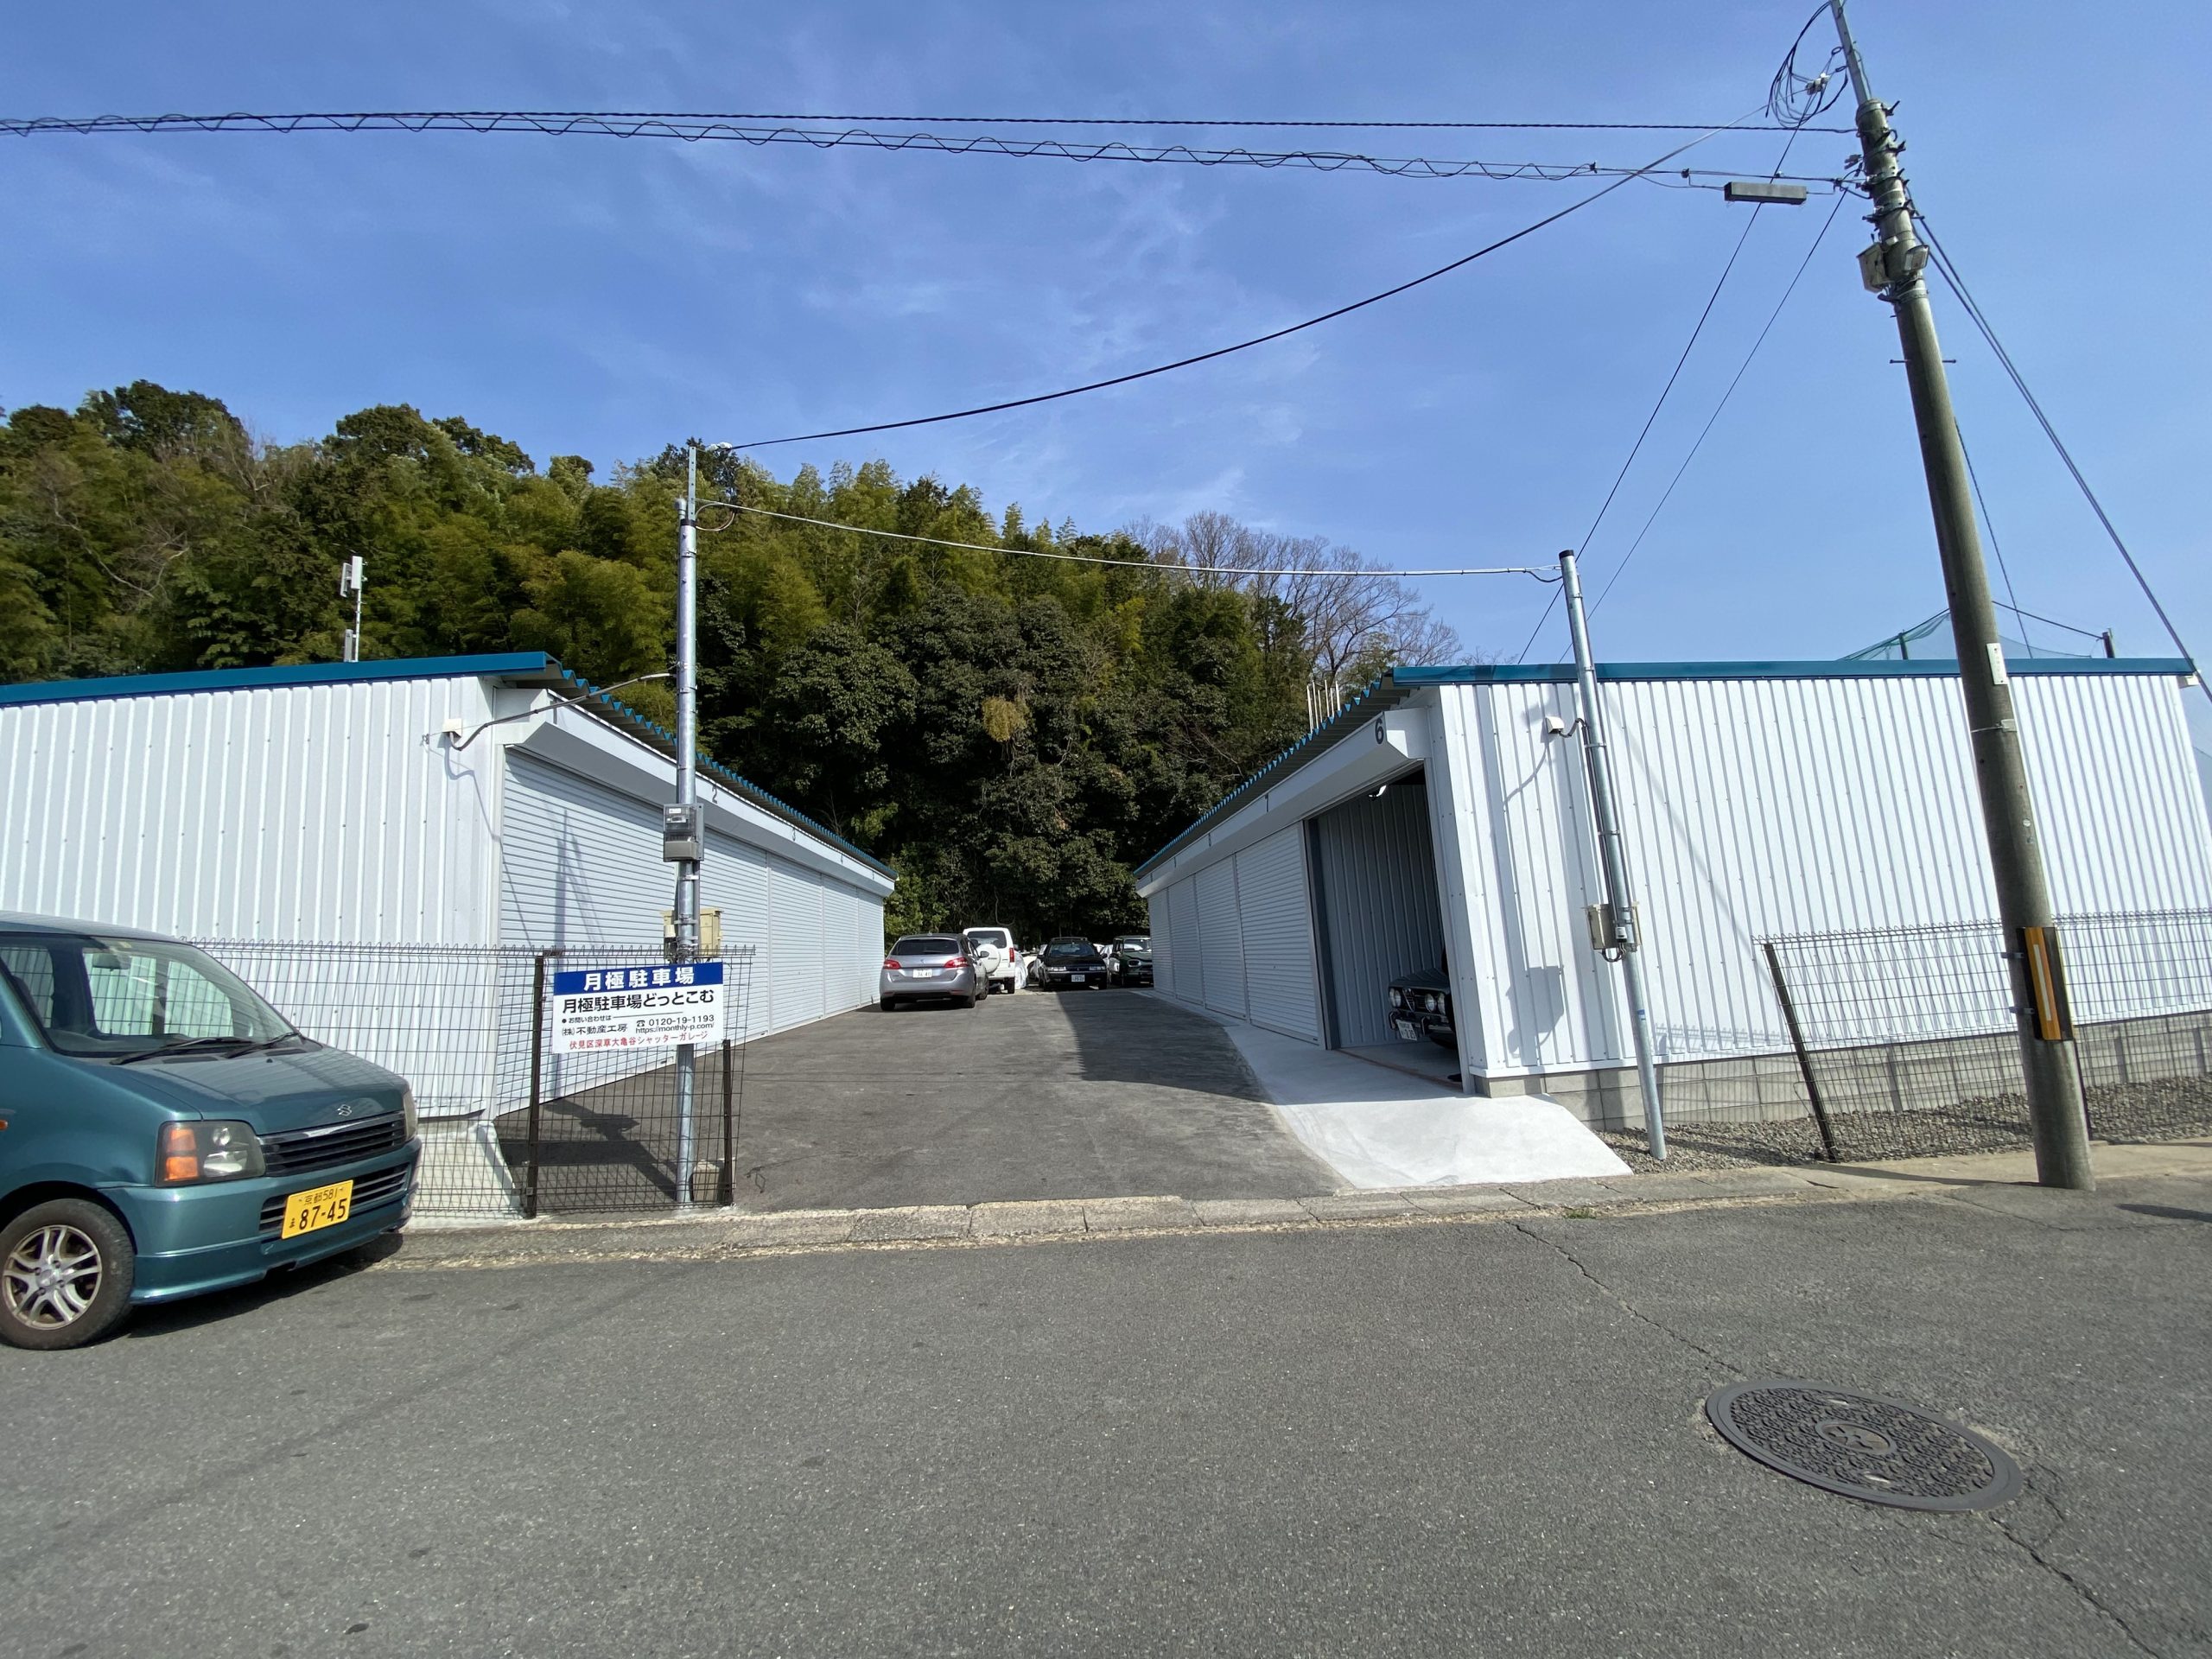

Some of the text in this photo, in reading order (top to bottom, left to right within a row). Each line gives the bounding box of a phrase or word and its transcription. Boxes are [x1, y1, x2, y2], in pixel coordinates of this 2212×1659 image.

[1375, 717, 1384, 745] 6
[712, 785, 718, 804] 2
[583, 966, 695, 991] 月極駐車場
[563, 989, 715, 1014] 月極駐車場どっとこむ
[569, 1015, 612, 1024] お問い合わせは
[635, 1022, 715, 1034] https://monthly-p.com/
[648, 1014, 715, 1026] 0120-19-1193
[569, 1031, 708, 1050] 伏見区深草大亀谷シャッターガレージ
[299, 1198, 347, 1230] 87-45
